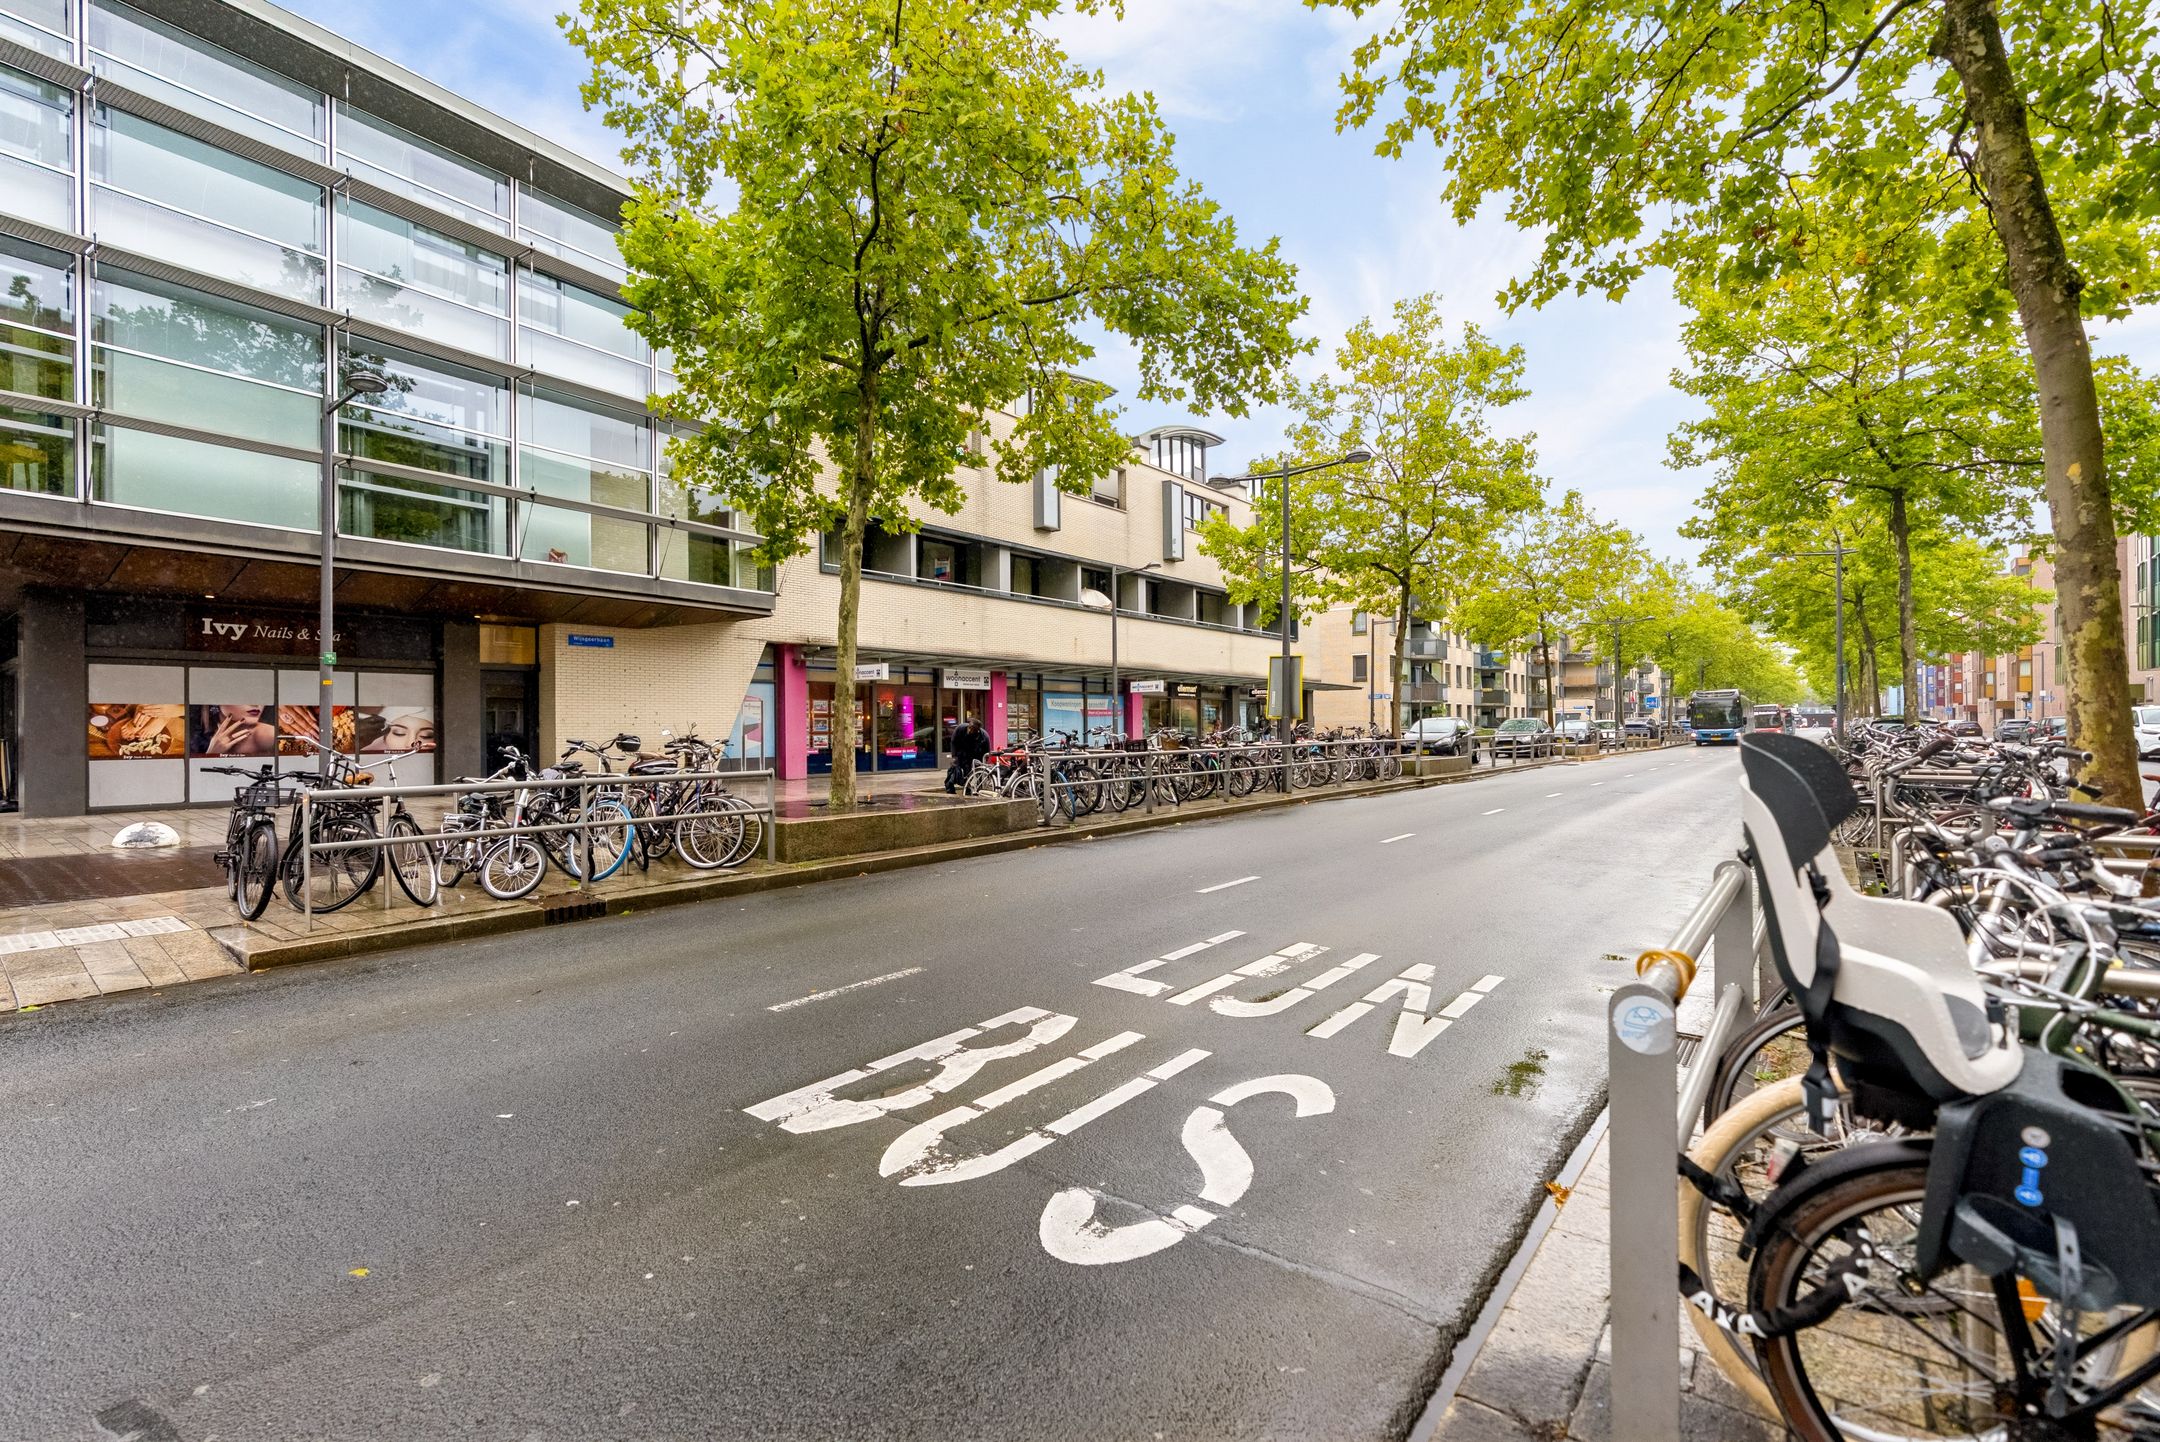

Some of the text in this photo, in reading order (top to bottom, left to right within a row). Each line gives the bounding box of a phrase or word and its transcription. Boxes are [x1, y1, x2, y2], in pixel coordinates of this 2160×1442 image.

[202, 618, 341, 642] Ivy Nails & Sa
[945, 675, 981, 683] woonaccent
[1092, 930, 1505, 1057] LIJN
[743, 1006, 1336, 1266] BUS
[1690, 1290, 1768, 1339] AXA
